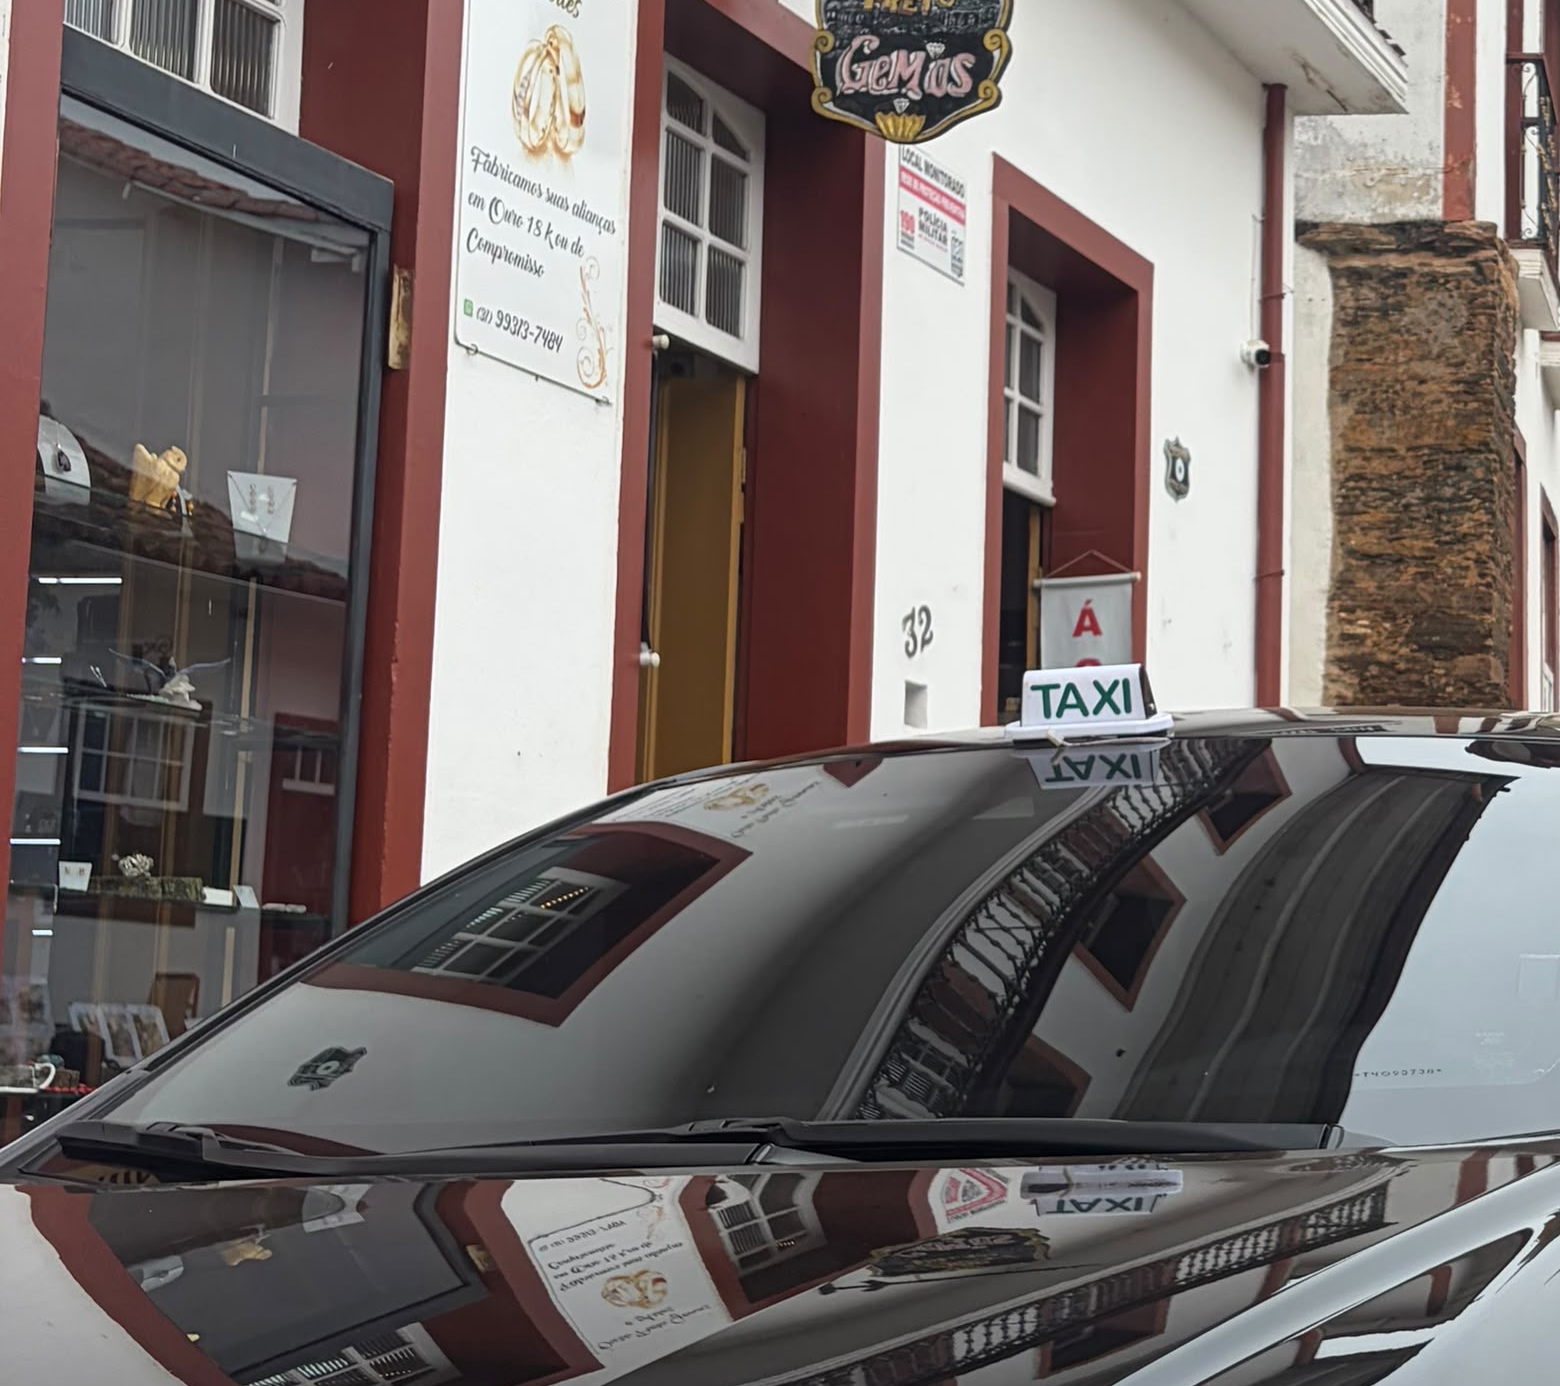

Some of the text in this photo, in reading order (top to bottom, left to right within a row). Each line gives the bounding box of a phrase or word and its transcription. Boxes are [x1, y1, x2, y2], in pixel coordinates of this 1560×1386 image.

[902, 145, 922, 172] LOCAL
[470, 145, 616, 236] Fabricamos suas alianças
[467, 192, 486, 211] em
[488, 196, 524, 228] Ouro
[527, 215, 543, 237] 18
[555, 233, 568, 251] ou
[571, 235, 584, 258] de
[466, 227, 545, 278] Compromisso
[476, 306, 563, 353] (31) 99313-7484
[902, 605, 933, 659] 32
[1031, 678, 1131, 719] TAXI
